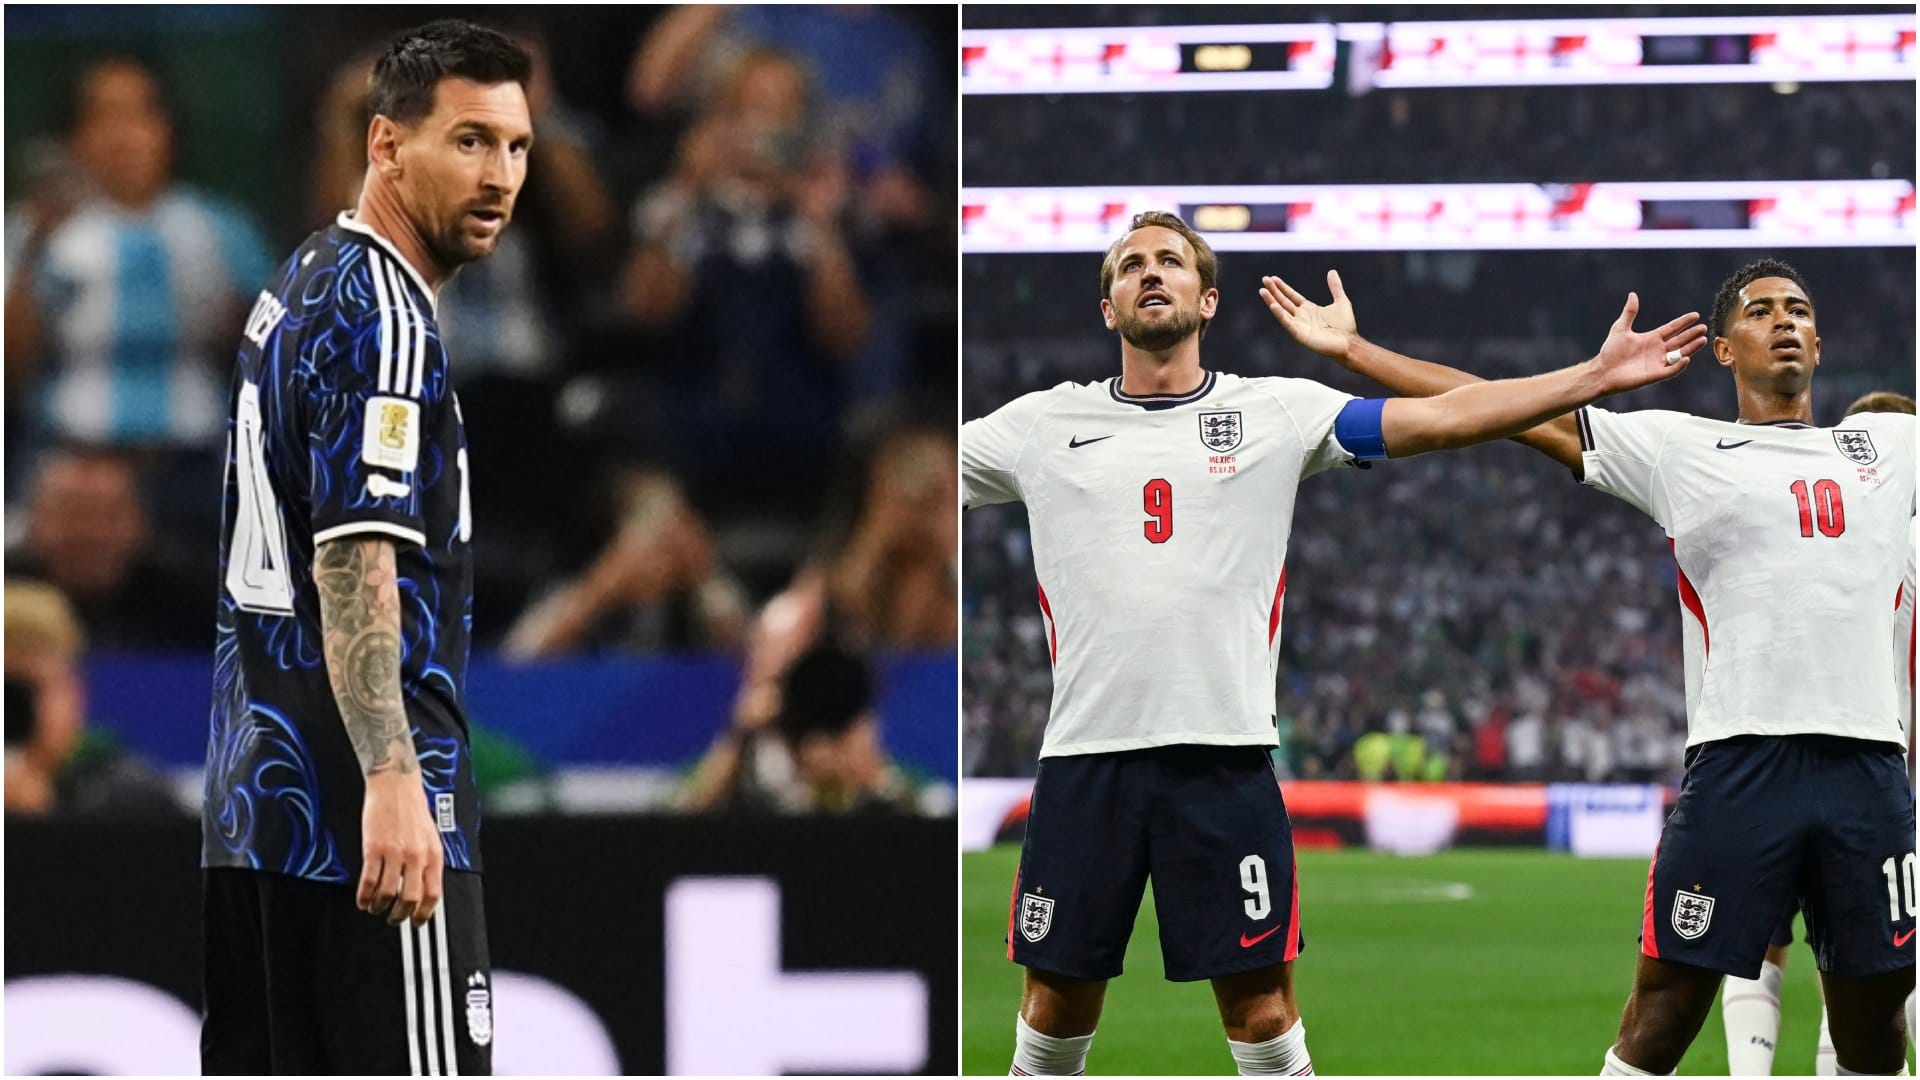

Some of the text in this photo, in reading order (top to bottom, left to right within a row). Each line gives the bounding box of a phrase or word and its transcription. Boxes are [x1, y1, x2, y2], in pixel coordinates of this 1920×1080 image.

[1208, 456, 1237, 464] MEXICO
[1143, 478, 1174, 544] 9
[1790, 479, 1846, 538] 10
[1239, 854, 1271, 921] 9
